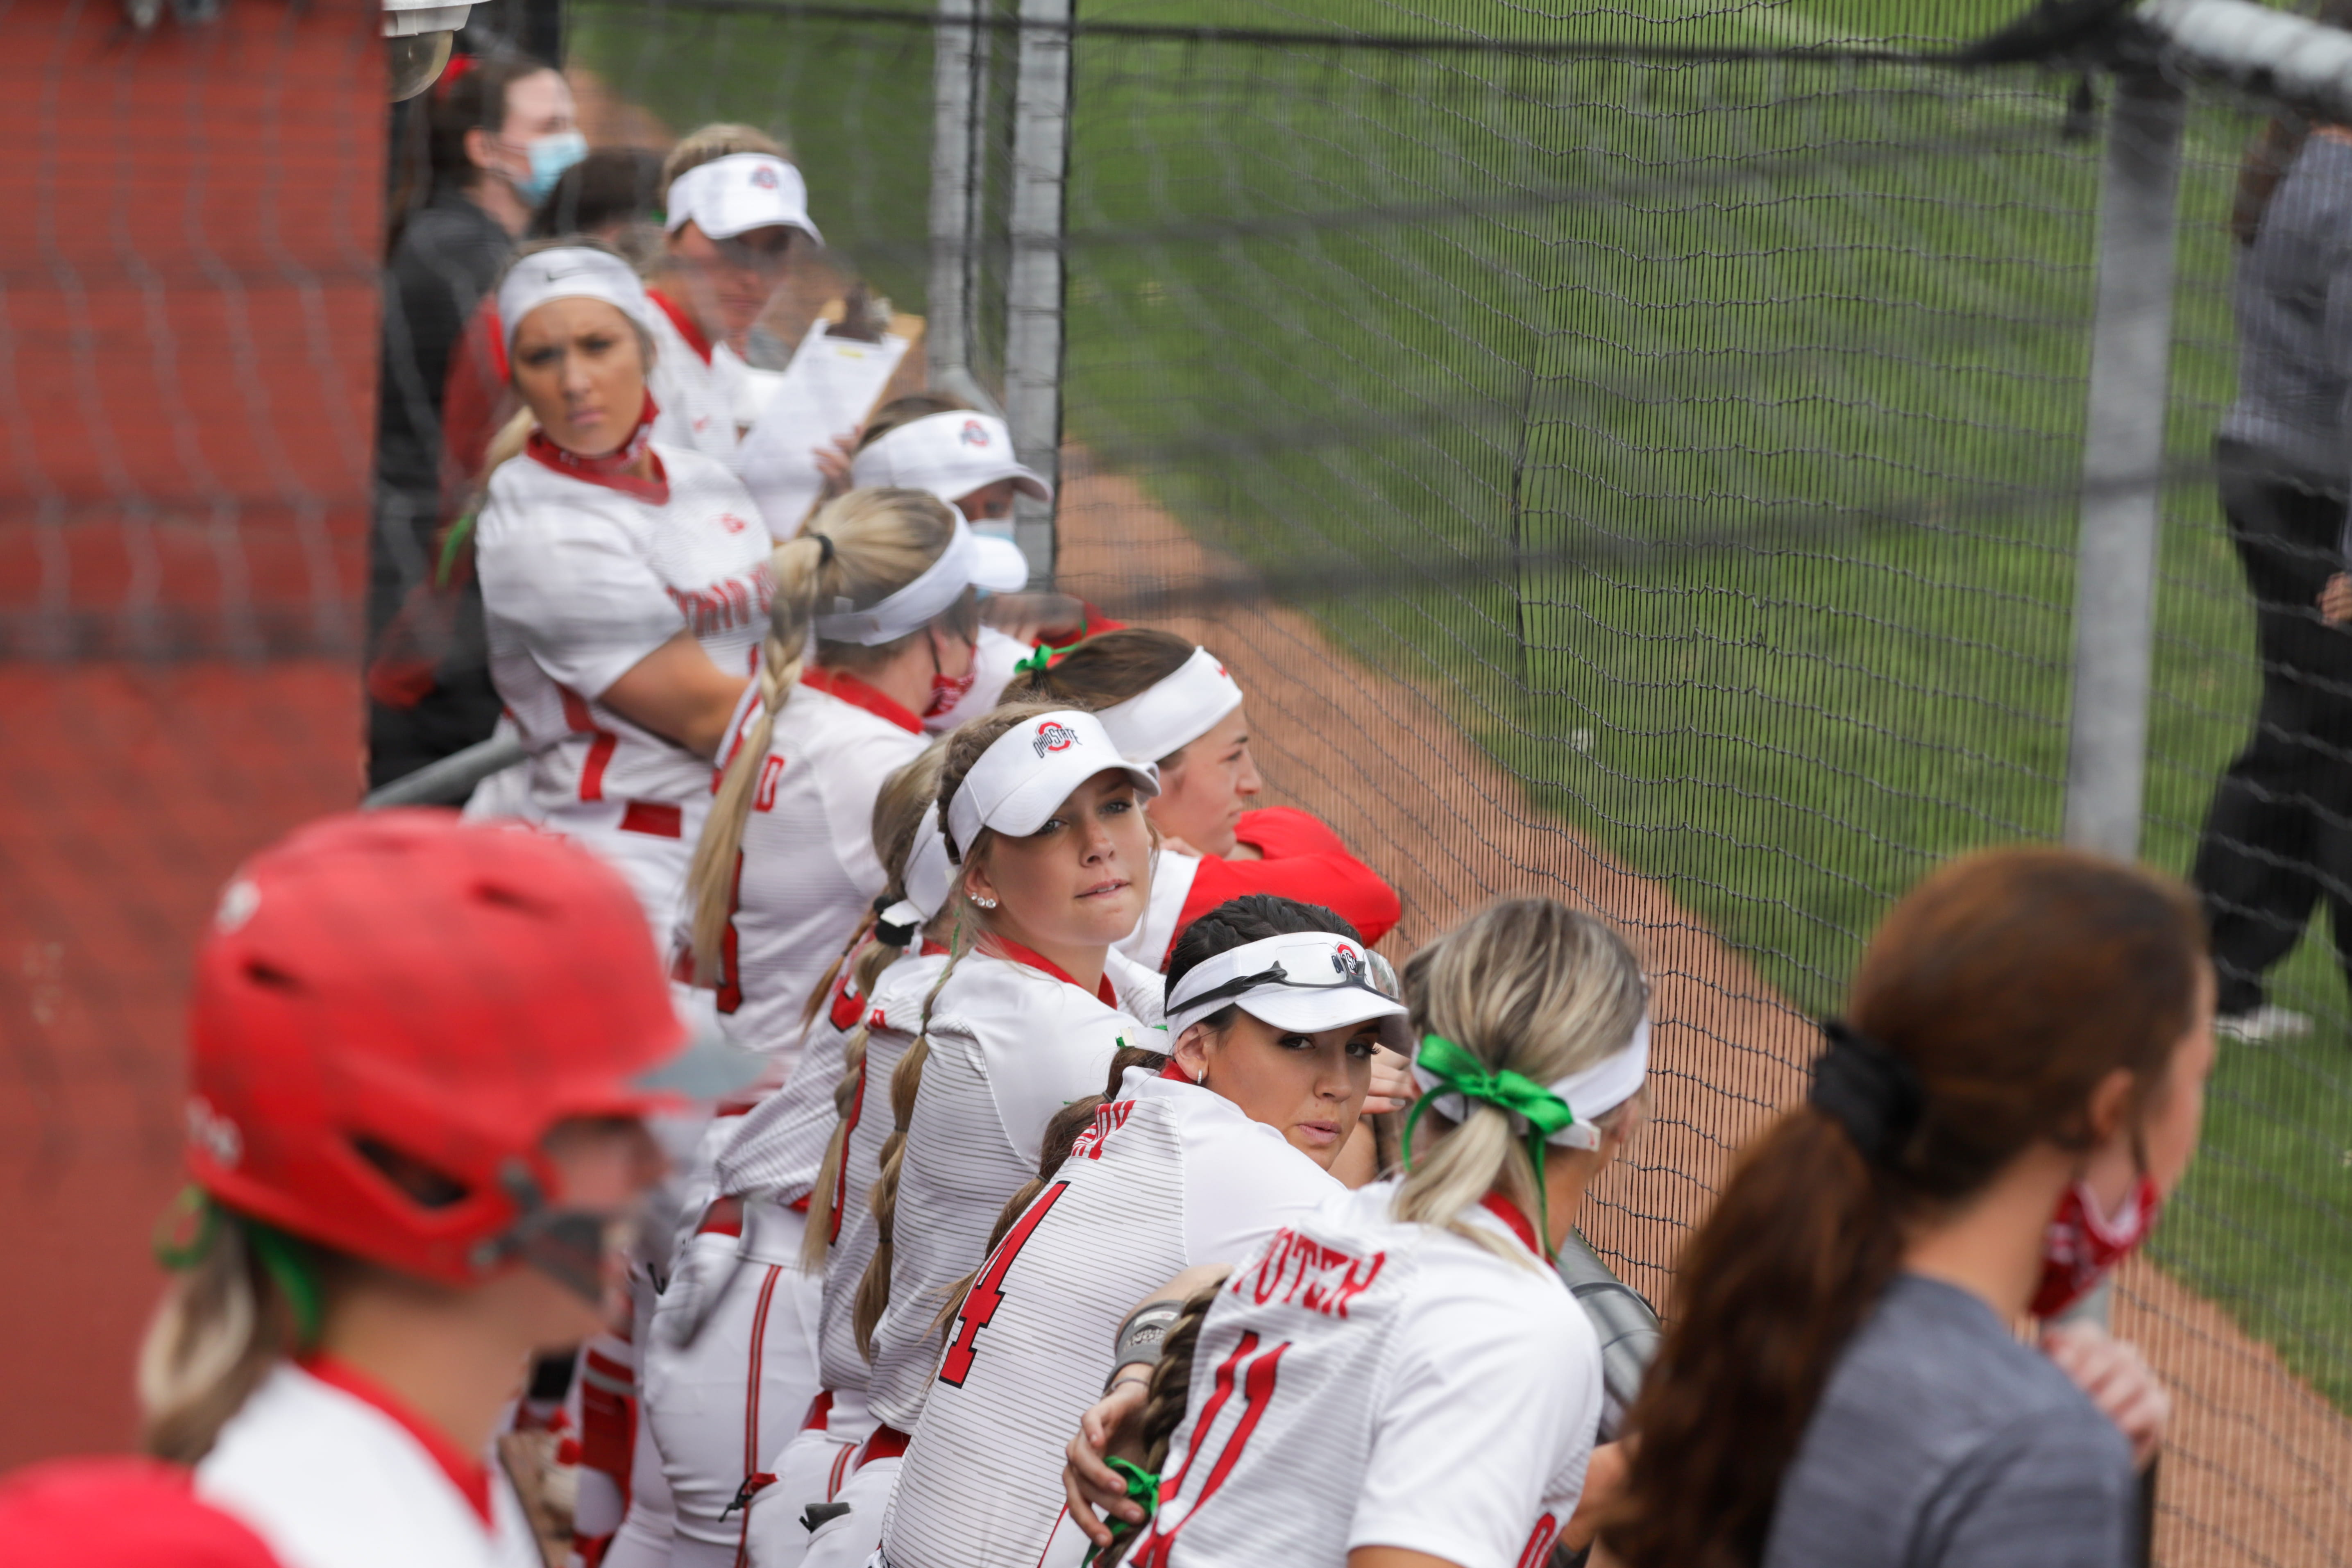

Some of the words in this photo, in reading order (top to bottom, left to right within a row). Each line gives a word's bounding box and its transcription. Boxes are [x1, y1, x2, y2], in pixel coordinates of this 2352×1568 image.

[1033, 733, 1053, 758] OHIO
[1048, 728, 1082, 746] STATE
[939, 1180, 1071, 1389] 4
